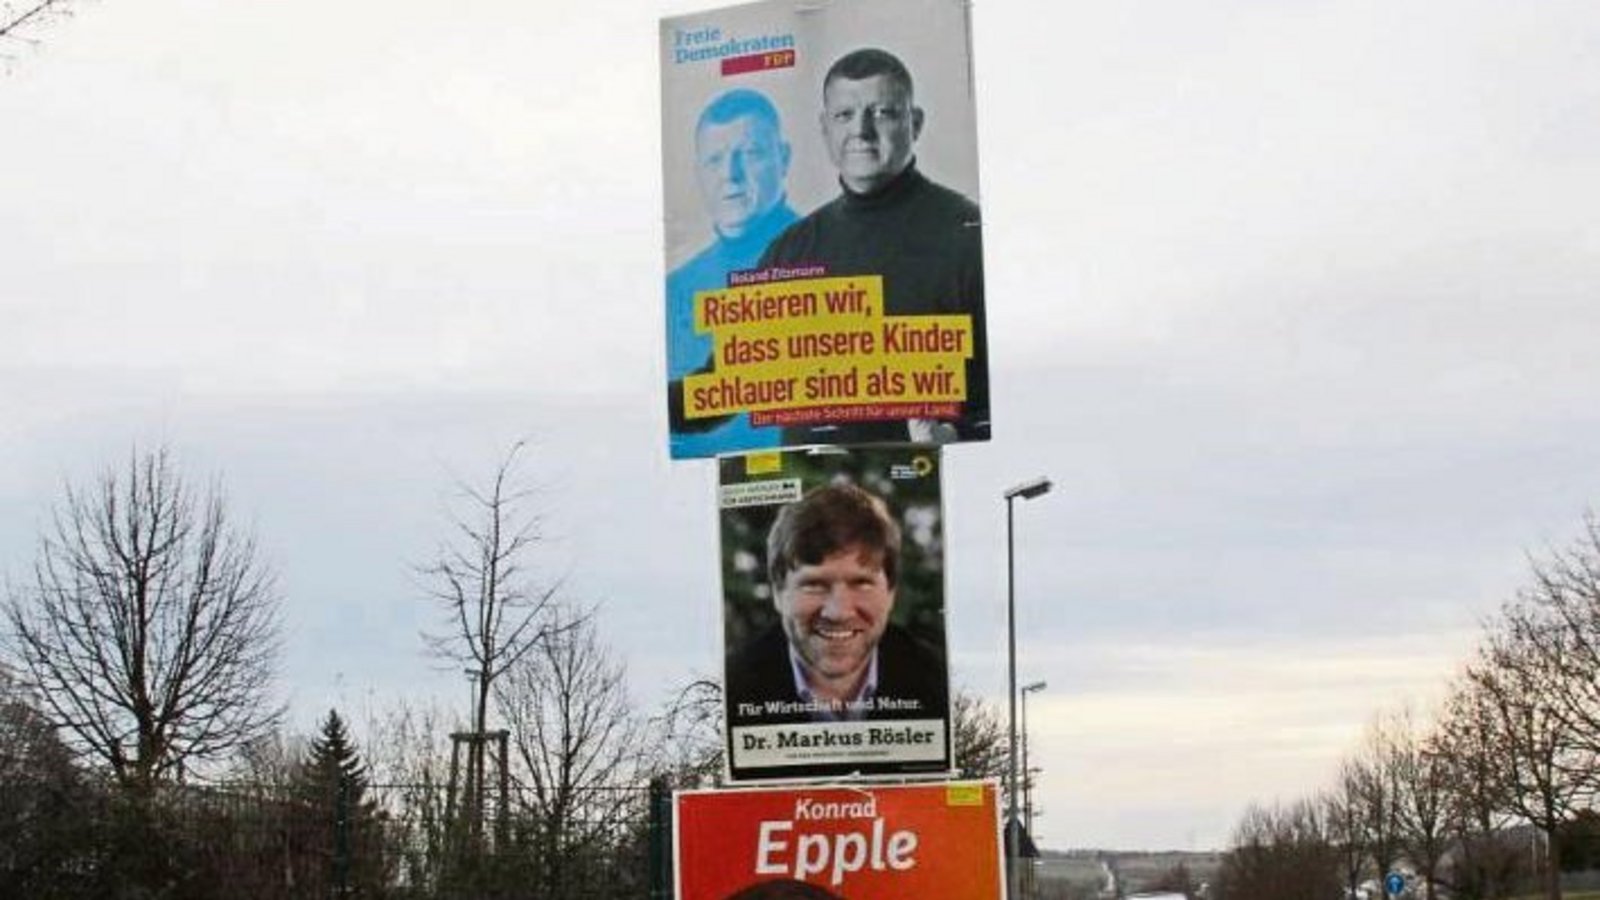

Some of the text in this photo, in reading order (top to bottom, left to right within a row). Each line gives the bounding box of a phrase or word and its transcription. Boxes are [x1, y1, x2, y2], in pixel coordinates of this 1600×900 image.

[676, 34, 795, 63] Demokraten
[703, 283, 873, 326] Riskieren wir,
[723, 323, 966, 365] dass unsere Kinder
[693, 364, 961, 411] schlauer sind als wir.
[739, 702, 763, 716] Für
[878, 697, 921, 711] Natur.
[743, 727, 935, 750] Dr. Markus Rösler
[794, 796, 877, 820] Konrad
[755, 817, 919, 886] Epple
